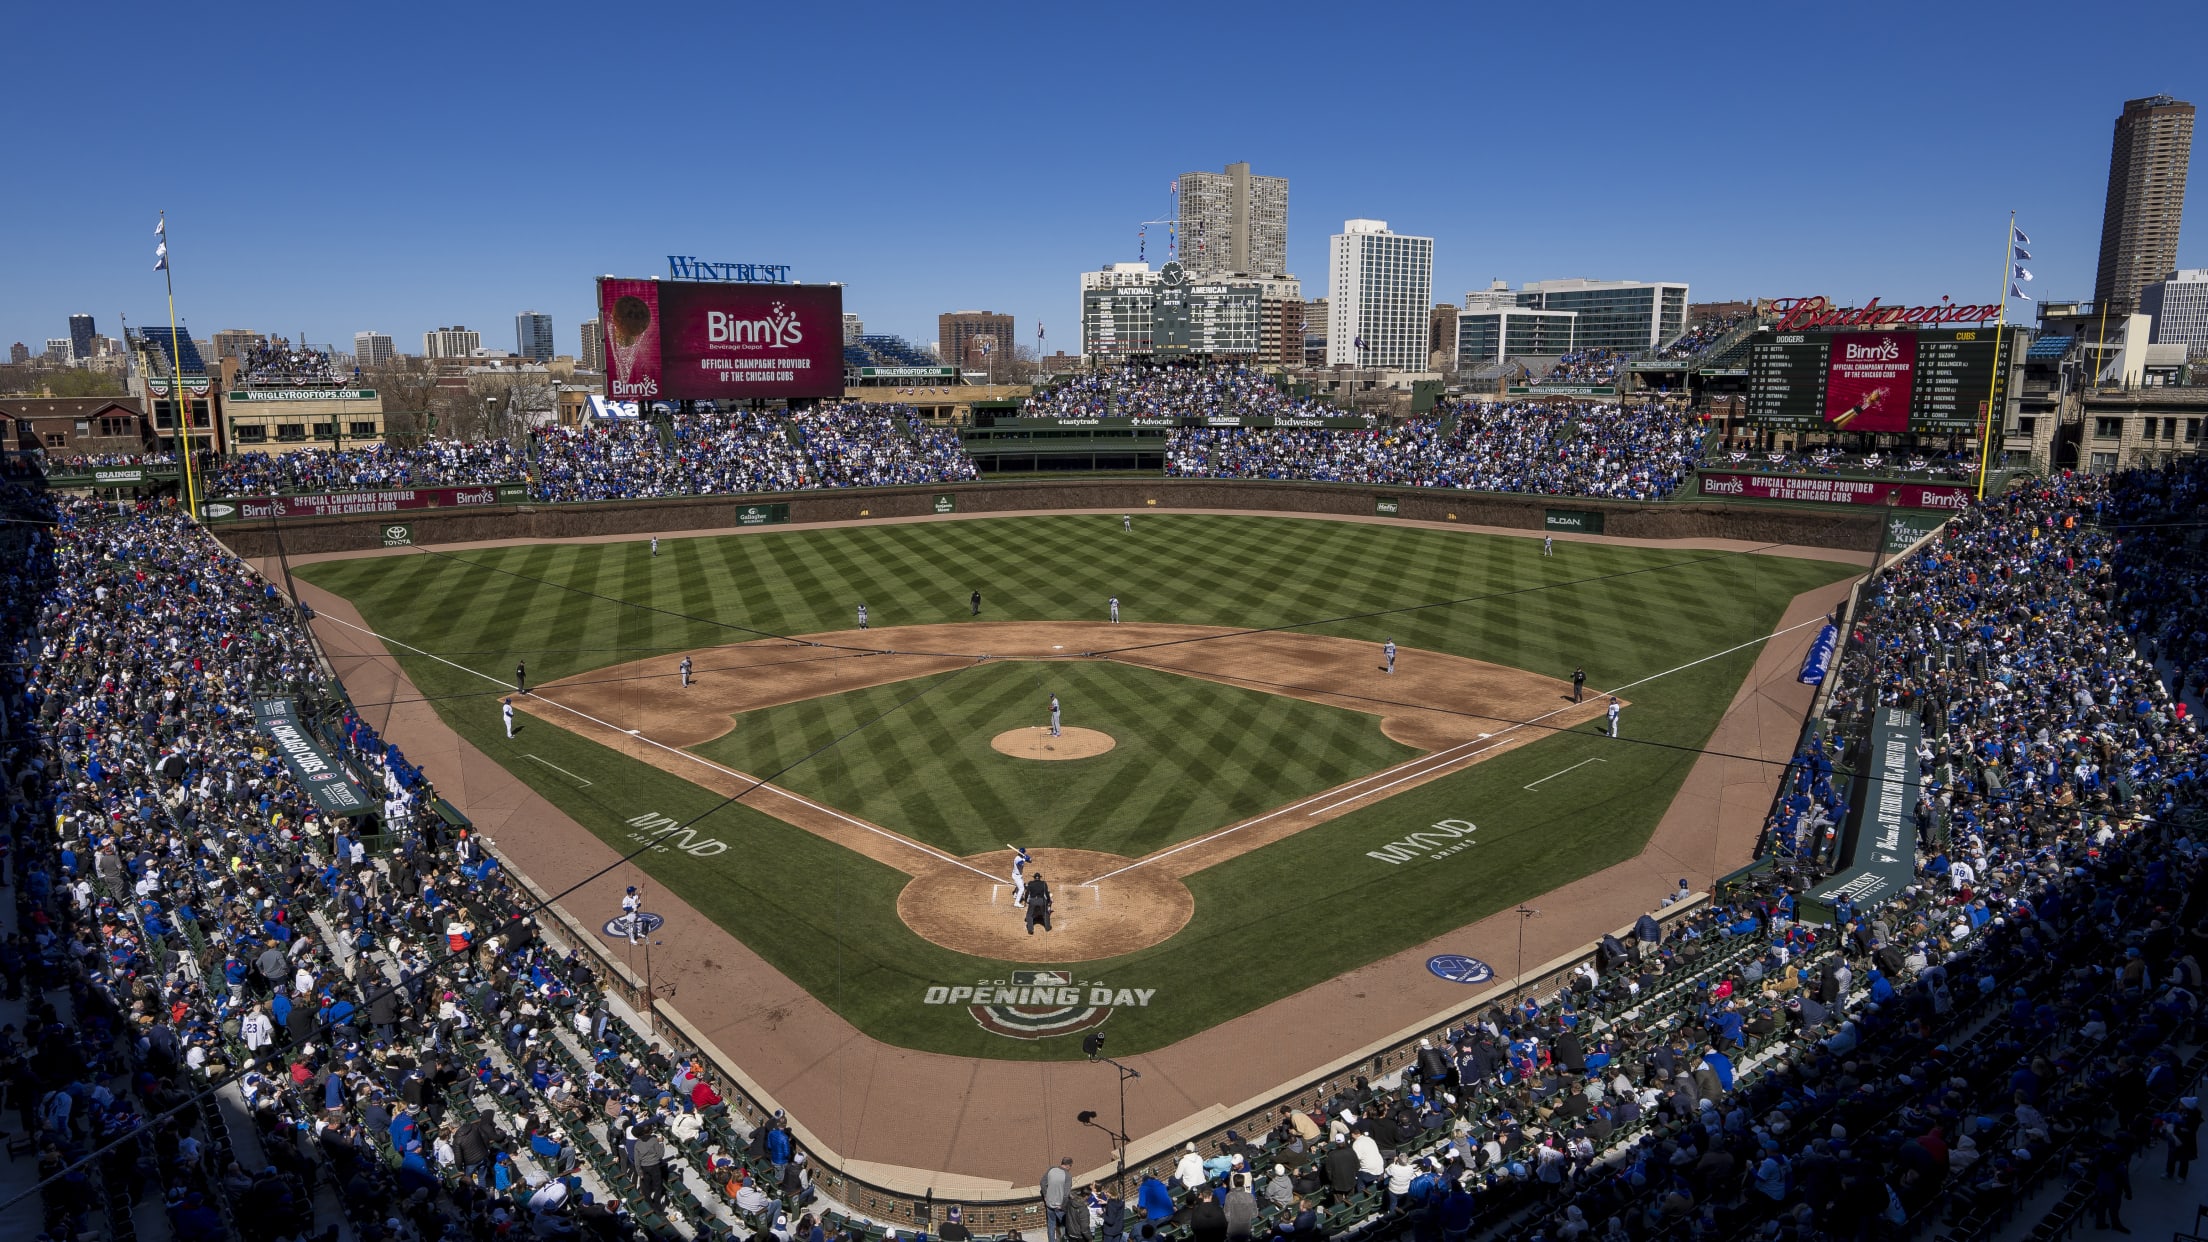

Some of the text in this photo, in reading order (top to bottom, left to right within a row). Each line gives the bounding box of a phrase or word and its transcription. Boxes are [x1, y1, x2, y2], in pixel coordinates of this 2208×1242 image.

[667, 256, 790, 282] WINTRUST
[1770, 295, 2002, 332] Budweiser
[701, 358, 811, 369] OFFICIAL CHAMPAGNE PROVIDER
[720, 371, 794, 382] OF THE CHICAGO CUBS
[248, 390, 360, 400] WRIGLEYROOFTOPS.COM
[1274, 417, 1324, 426] Budweiser
[1752, 477, 1874, 494] OFFICIAL CHAMPAGNE PROVIDER
[294, 491, 415, 507] OFFICIAL CHAMPAGNE PROVIDER
[1770, 488, 1852, 502] OF THE CHICAGO CUBS
[316, 502, 397, 515] OF THE CHICAGO CUBS
[271, 725, 328, 774] CHICAGO CUBS
[1366, 819, 1477, 865] MYND
[1431, 839, 1477, 860] DRINKS
[1819, 872, 1880, 899] WINTRUST
[923, 986, 1156, 1006] OPENING DAY
[247, 1024, 257, 1033] 23
